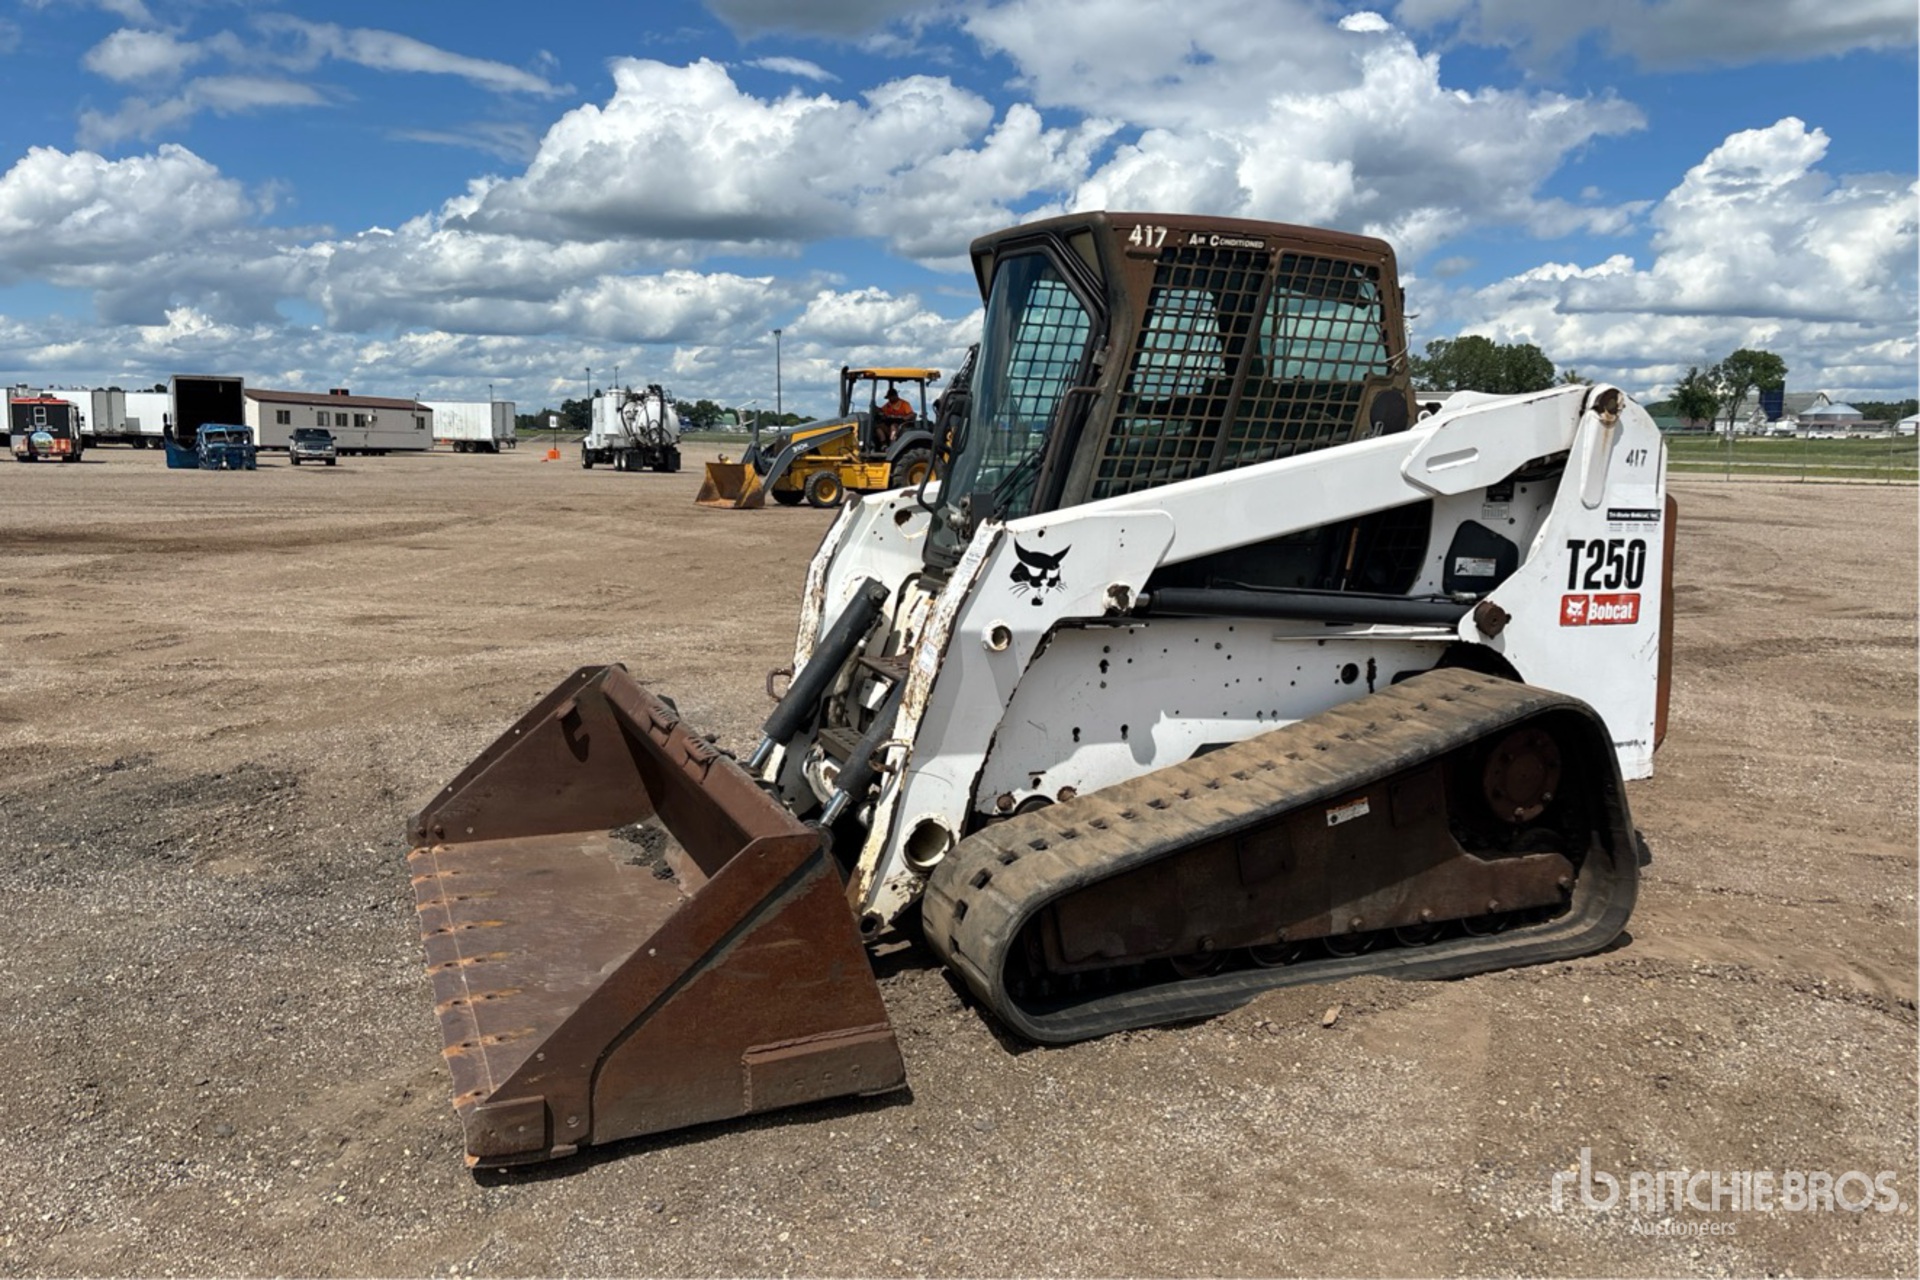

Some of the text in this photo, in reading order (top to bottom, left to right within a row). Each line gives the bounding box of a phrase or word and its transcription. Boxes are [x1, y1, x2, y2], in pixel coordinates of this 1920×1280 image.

[1128, 224, 1168, 248] 417
[1626, 449, 1648, 467] 417
[1566, 538, 1647, 590] T250
[1589, 602, 1634, 620] Bobcat
